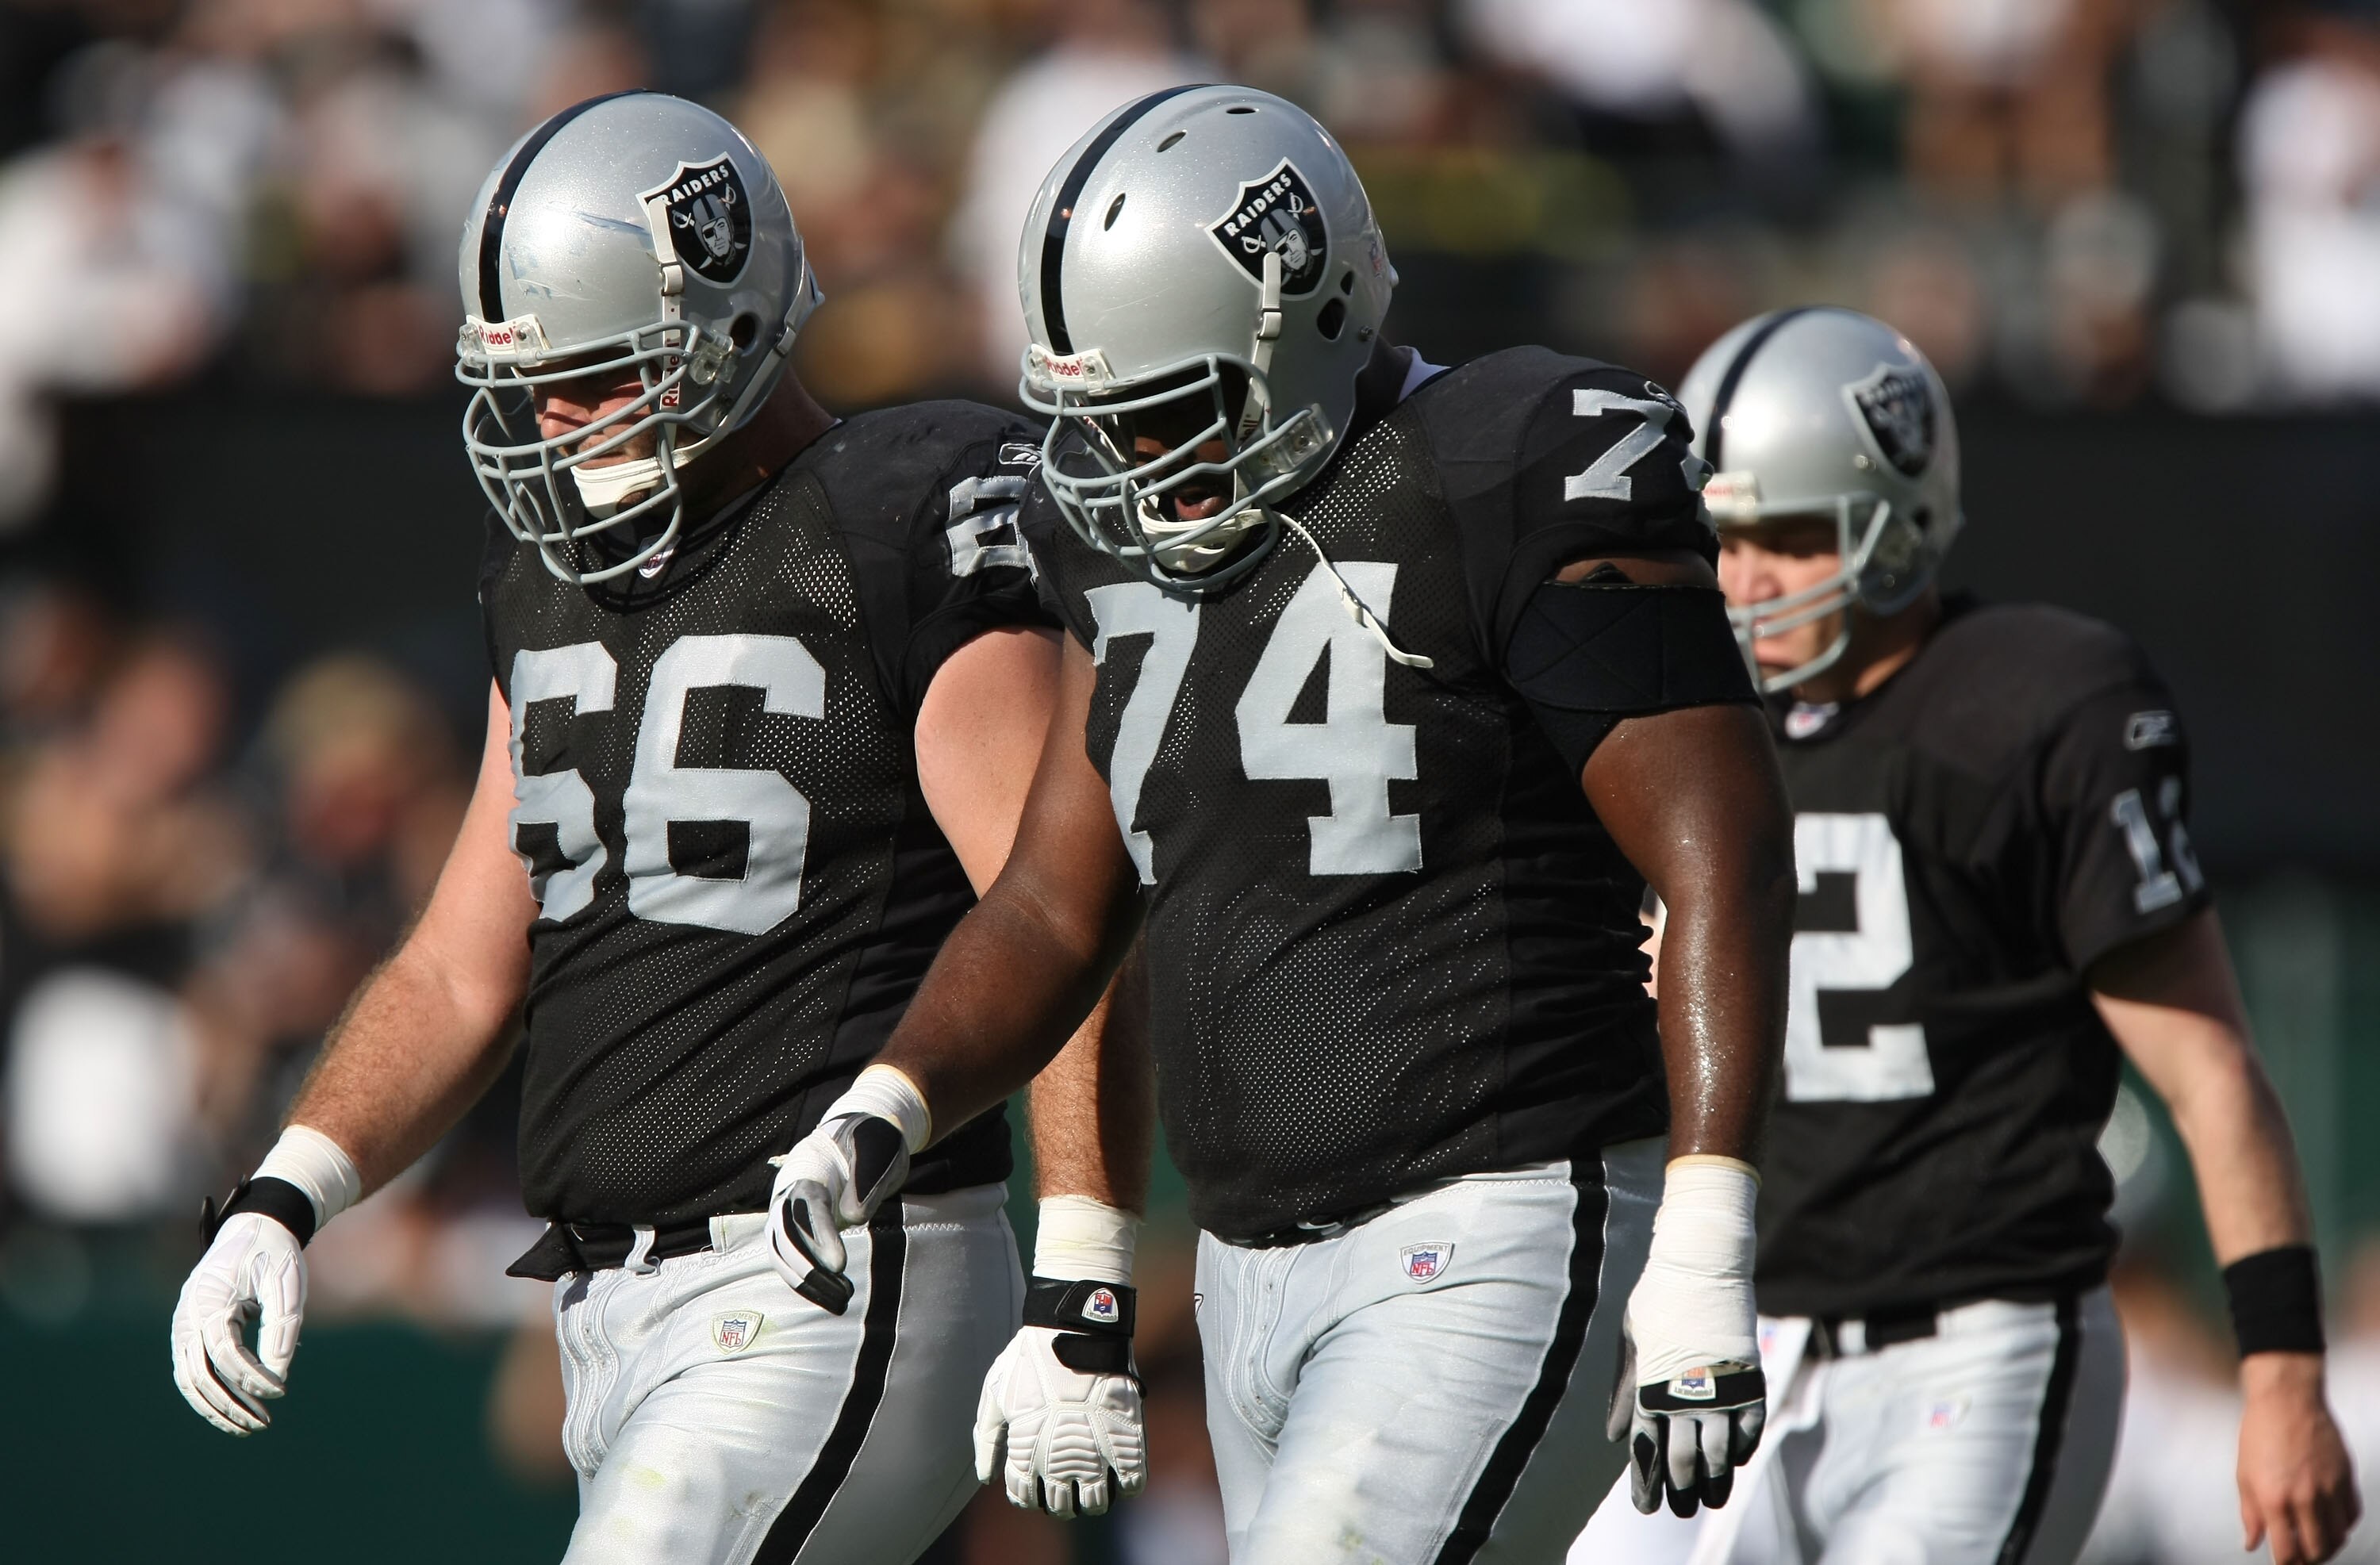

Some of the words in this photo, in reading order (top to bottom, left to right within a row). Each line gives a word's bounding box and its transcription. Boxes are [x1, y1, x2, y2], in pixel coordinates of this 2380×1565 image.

[657, 164, 729, 206] RAIDERS
[1223, 173, 1292, 237] RAIDERS
[1084, 561, 1422, 885] 74
[508, 634, 826, 936] 66
[1411, 1263, 1434, 1276] NFL
[720, 1331, 742, 1346] NFL
